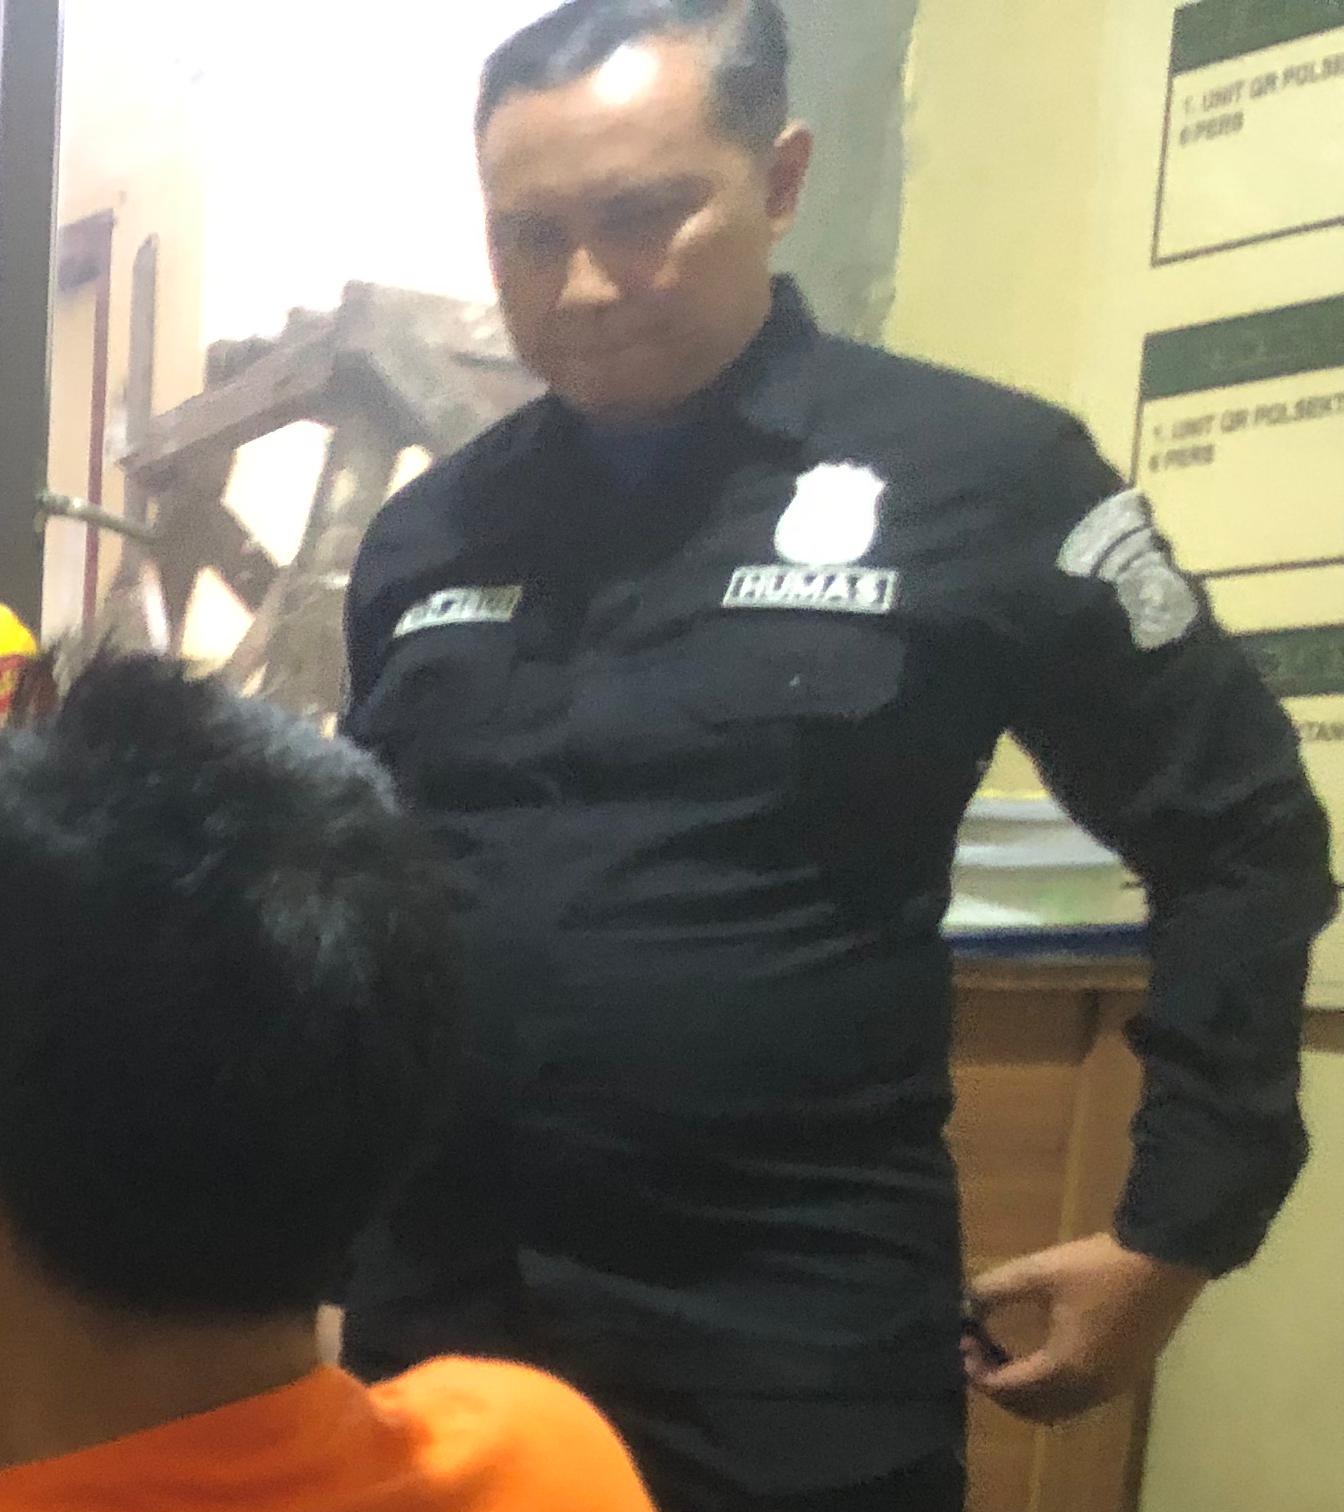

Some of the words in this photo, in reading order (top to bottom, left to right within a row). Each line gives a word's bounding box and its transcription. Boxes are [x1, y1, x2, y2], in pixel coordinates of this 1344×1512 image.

[1202, 79, 1245, 112] UNIT
[1171, 414, 1216, 440] UNIT
[736, 569, 881, 606] HUMAS
